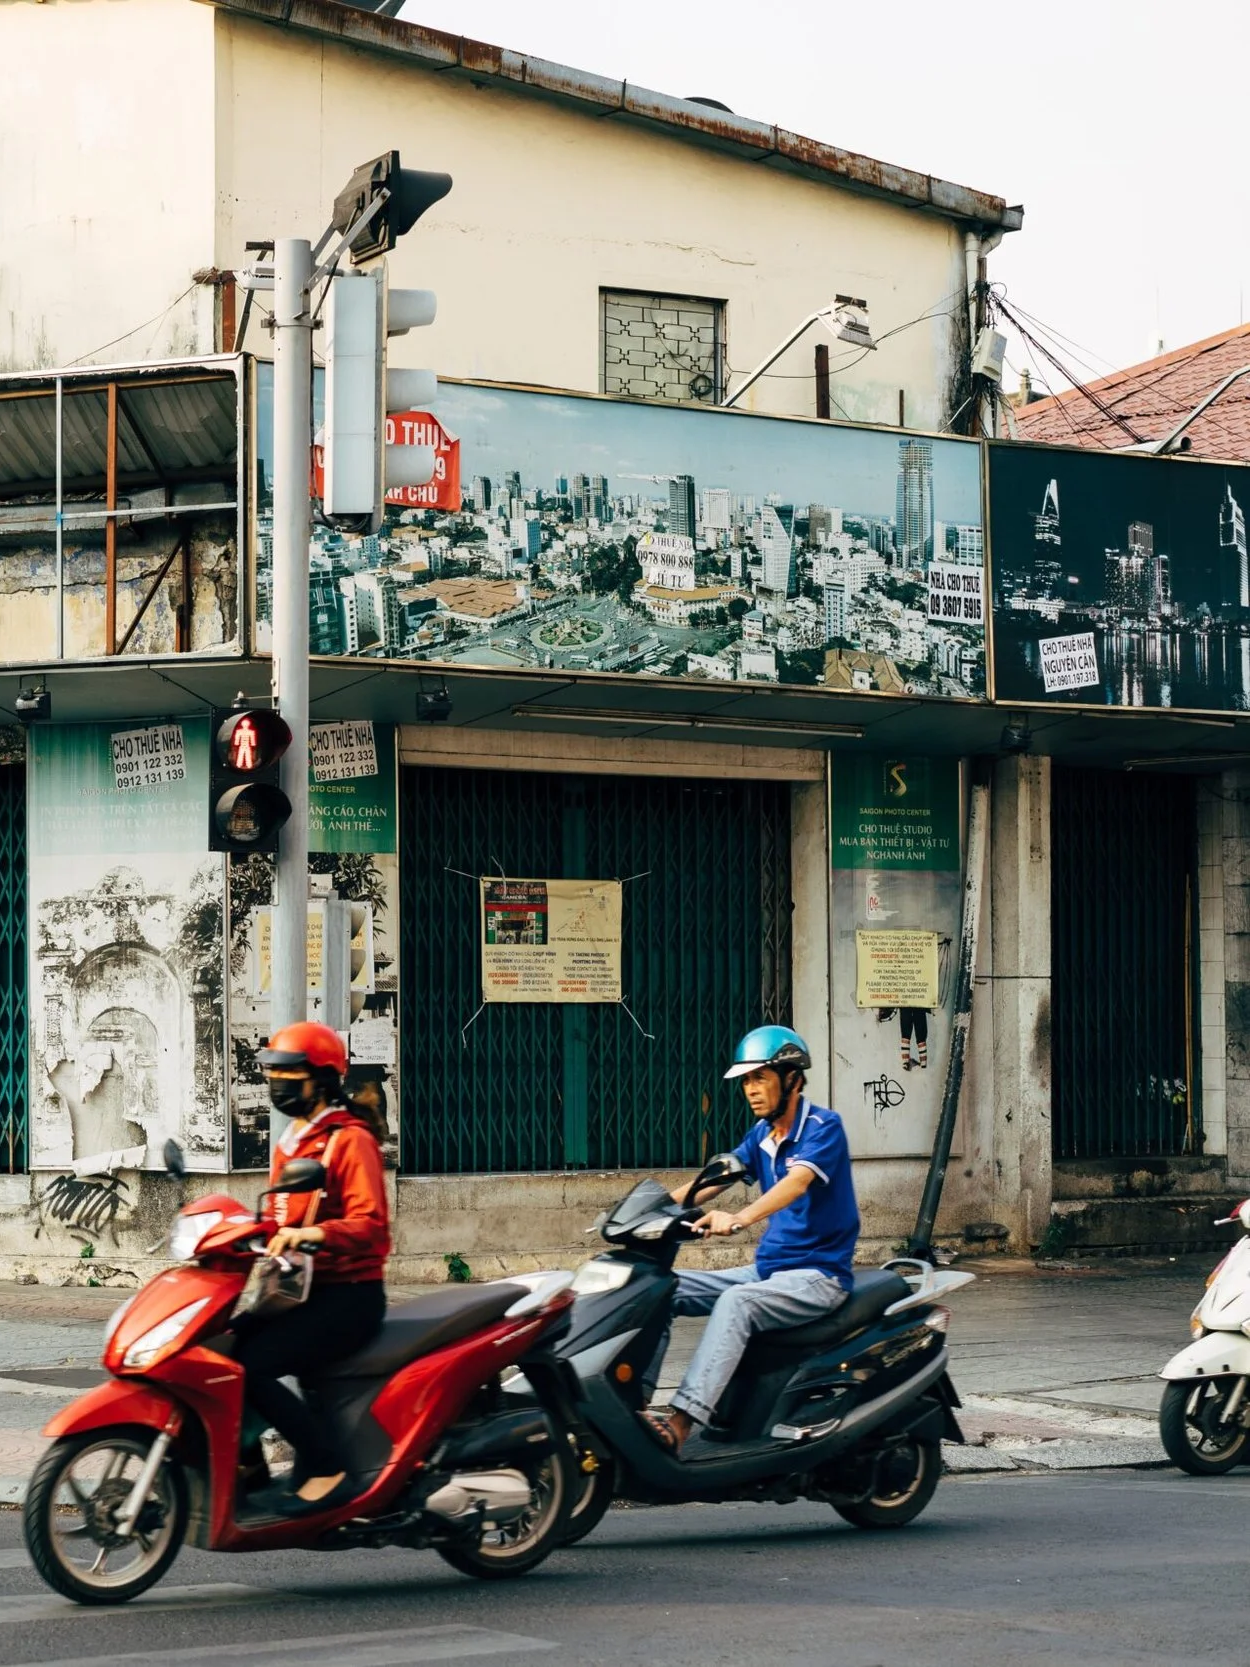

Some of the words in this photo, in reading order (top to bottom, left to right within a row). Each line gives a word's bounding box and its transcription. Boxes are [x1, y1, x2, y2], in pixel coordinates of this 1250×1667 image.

[408, 481, 438, 504] CHỦ
[638, 550, 658, 566] 0978
[661, 553, 676, 568] 800
[678, 555, 694, 570] 888
[947, 573, 961, 592] CHO
[930, 593, 940, 616] 09
[964, 597, 982, 620] 5915
[1042, 641, 1058, 656] CHO
[1058, 636, 1077, 653] THUÊ
[1044, 655, 1077, 675] NGUYÊN
[112, 738, 134, 760] CHO
[134, 728, 161, 757] THUÊ
[162, 725, 183, 752] NHÀ
[310, 731, 330, 752] CHO
[331, 723, 354, 750] THUÊ
[116, 760, 140, 775] 0901
[143, 757, 162, 770] 122
[164, 753, 183, 767] 332
[314, 754, 336, 767] 0901
[339, 752, 355, 764] 122
[357, 749, 374, 762] 332
[117, 775, 142, 789] 0912
[145, 772, 162, 784] 131
[166, 768, 185, 781] 139
[315, 768, 338, 781] 0912
[340, 766, 356, 778] 131
[359, 763, 376, 775] 139
[326, 785, 356, 793] CENTER
[358, 805, 388, 817] CHÂN
[859, 807, 883, 816] SAIGON
[884, 808, 905, 816] PHOTO
[906, 808, 931, 816] CENTER
[859, 824, 877, 834] CHO
[879, 822, 901, 835] THUÊ
[903, 825, 933, 836] STUDIO
[840, 837, 858, 847] MUA
[860, 834, 878, 847] BÁN
[880, 834, 904, 848] THIẾT
[921, 836, 937, 850] VẬT
[939, 837, 950, 848] TƯ
